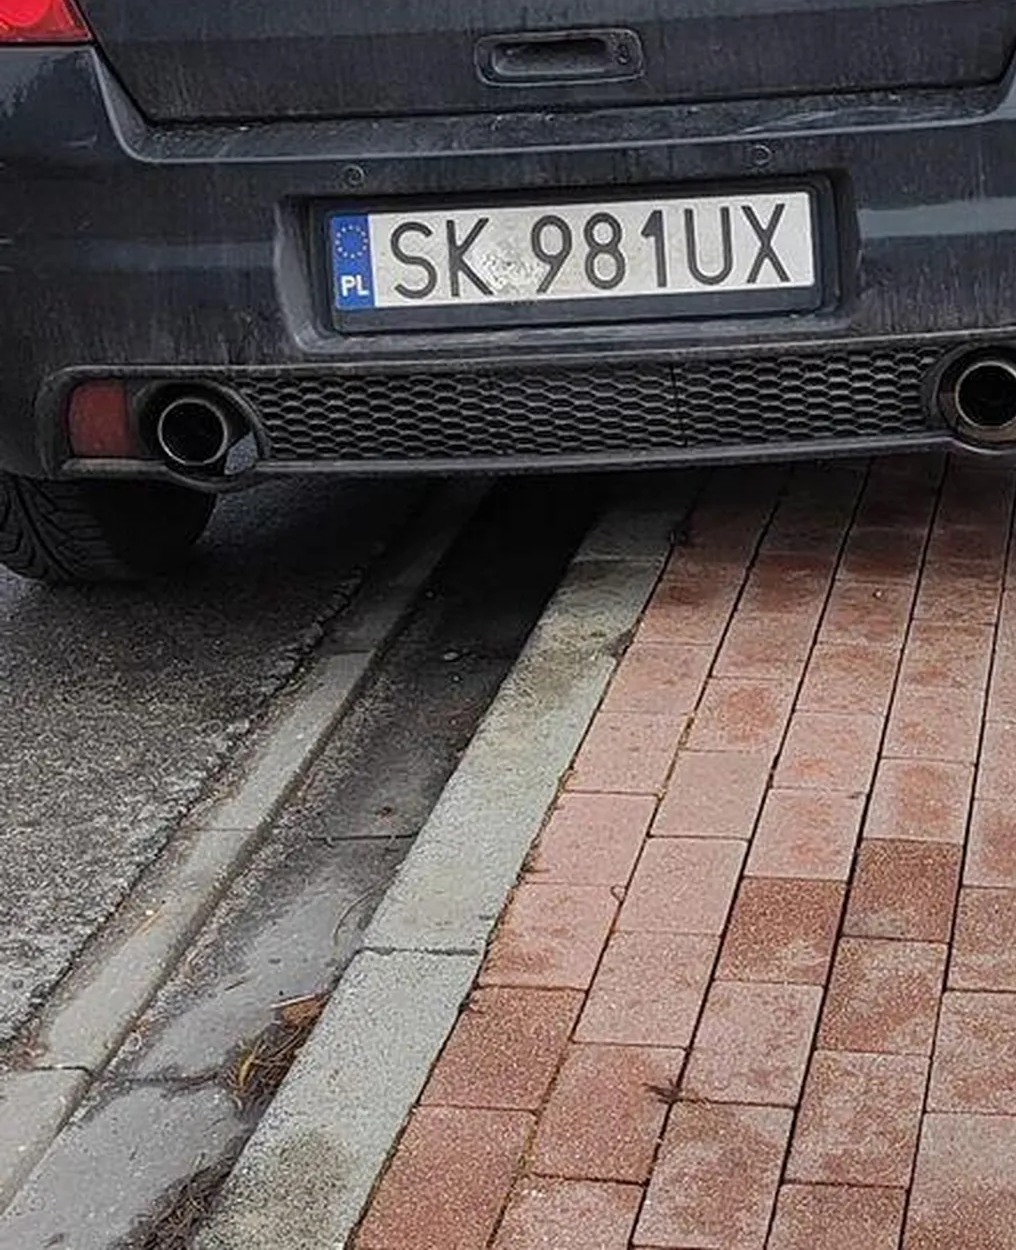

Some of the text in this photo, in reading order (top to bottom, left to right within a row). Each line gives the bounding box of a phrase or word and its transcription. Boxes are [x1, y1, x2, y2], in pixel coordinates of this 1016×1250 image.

[390, 203, 790, 299] SK 981UX
[340, 274, 370, 297] PL
